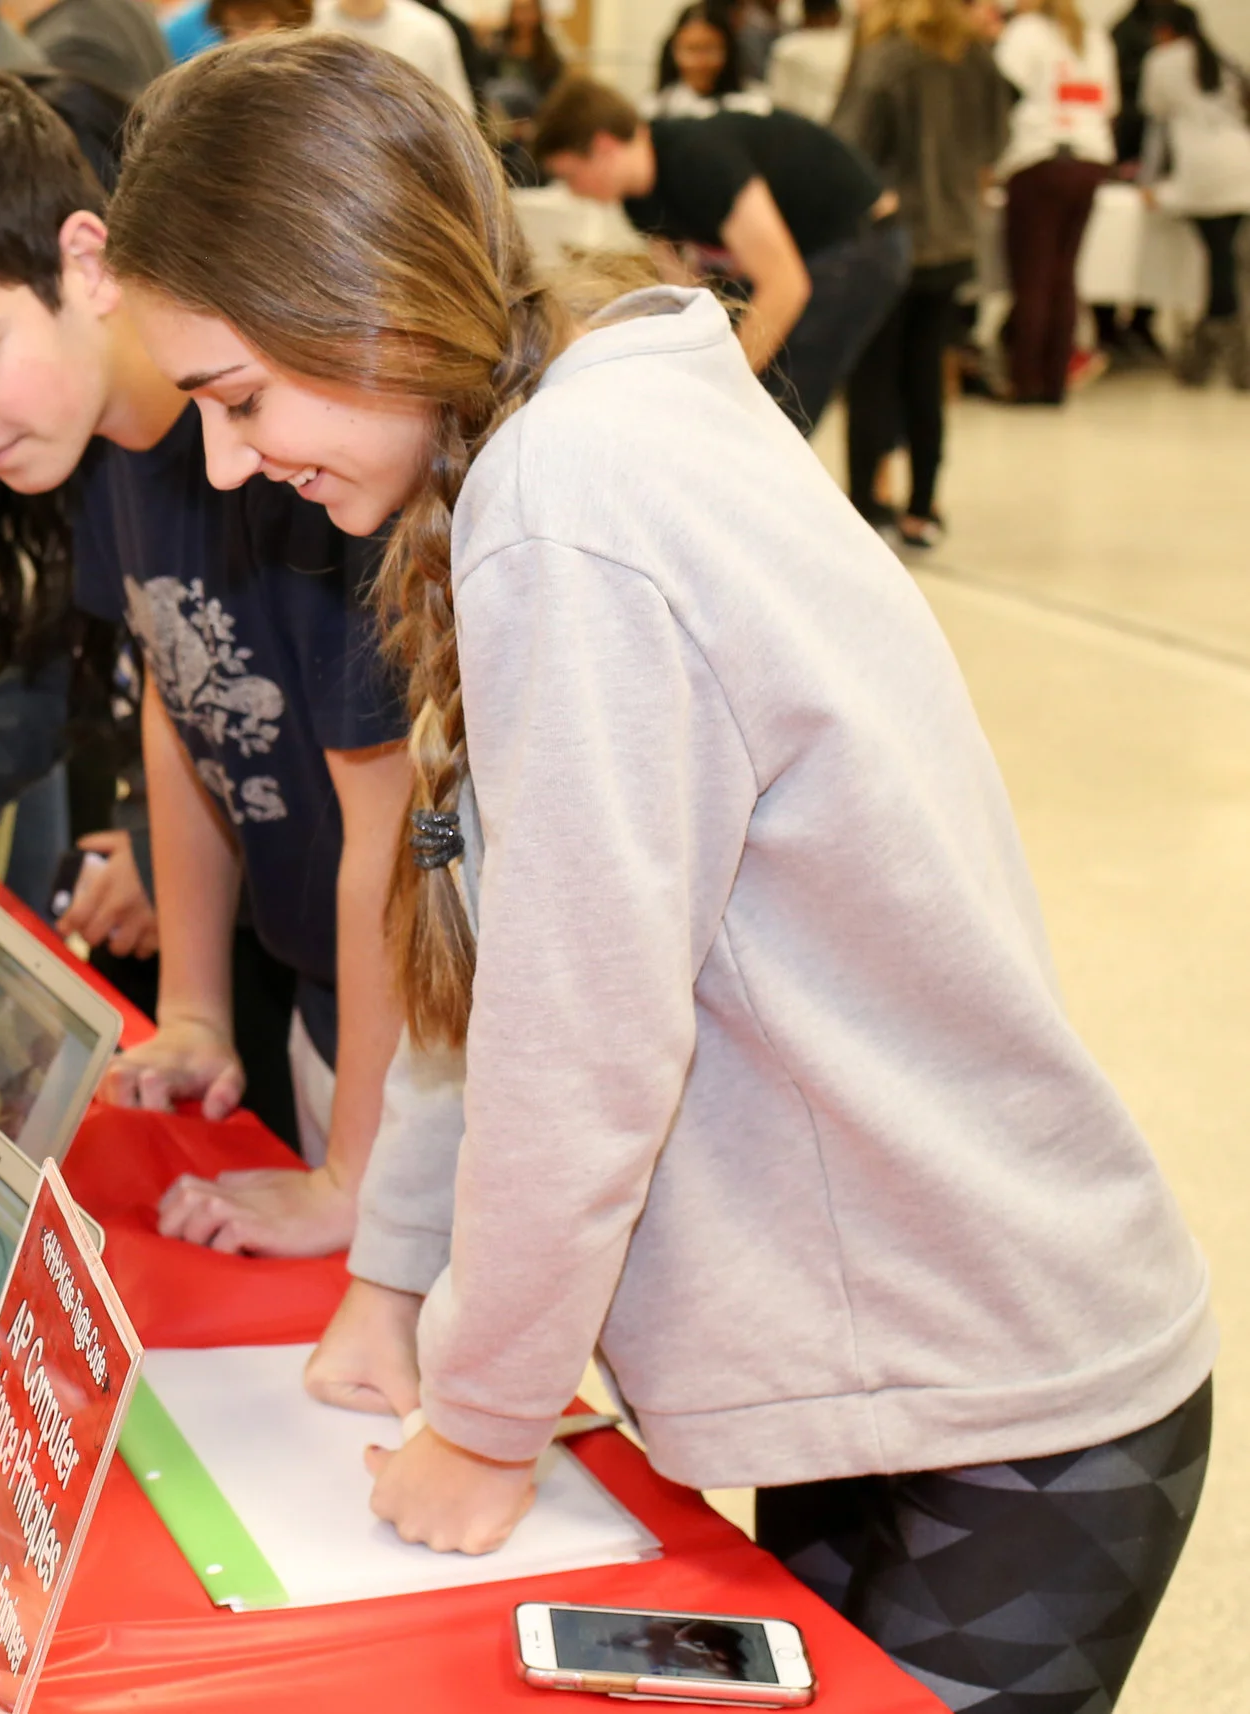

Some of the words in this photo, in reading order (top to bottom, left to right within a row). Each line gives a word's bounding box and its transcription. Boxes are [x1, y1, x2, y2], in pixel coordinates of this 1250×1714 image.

[5, 1299, 35, 1361] AP
[22, 1336, 80, 1491] Computer
[6, 1428, 62, 1593] Principles
